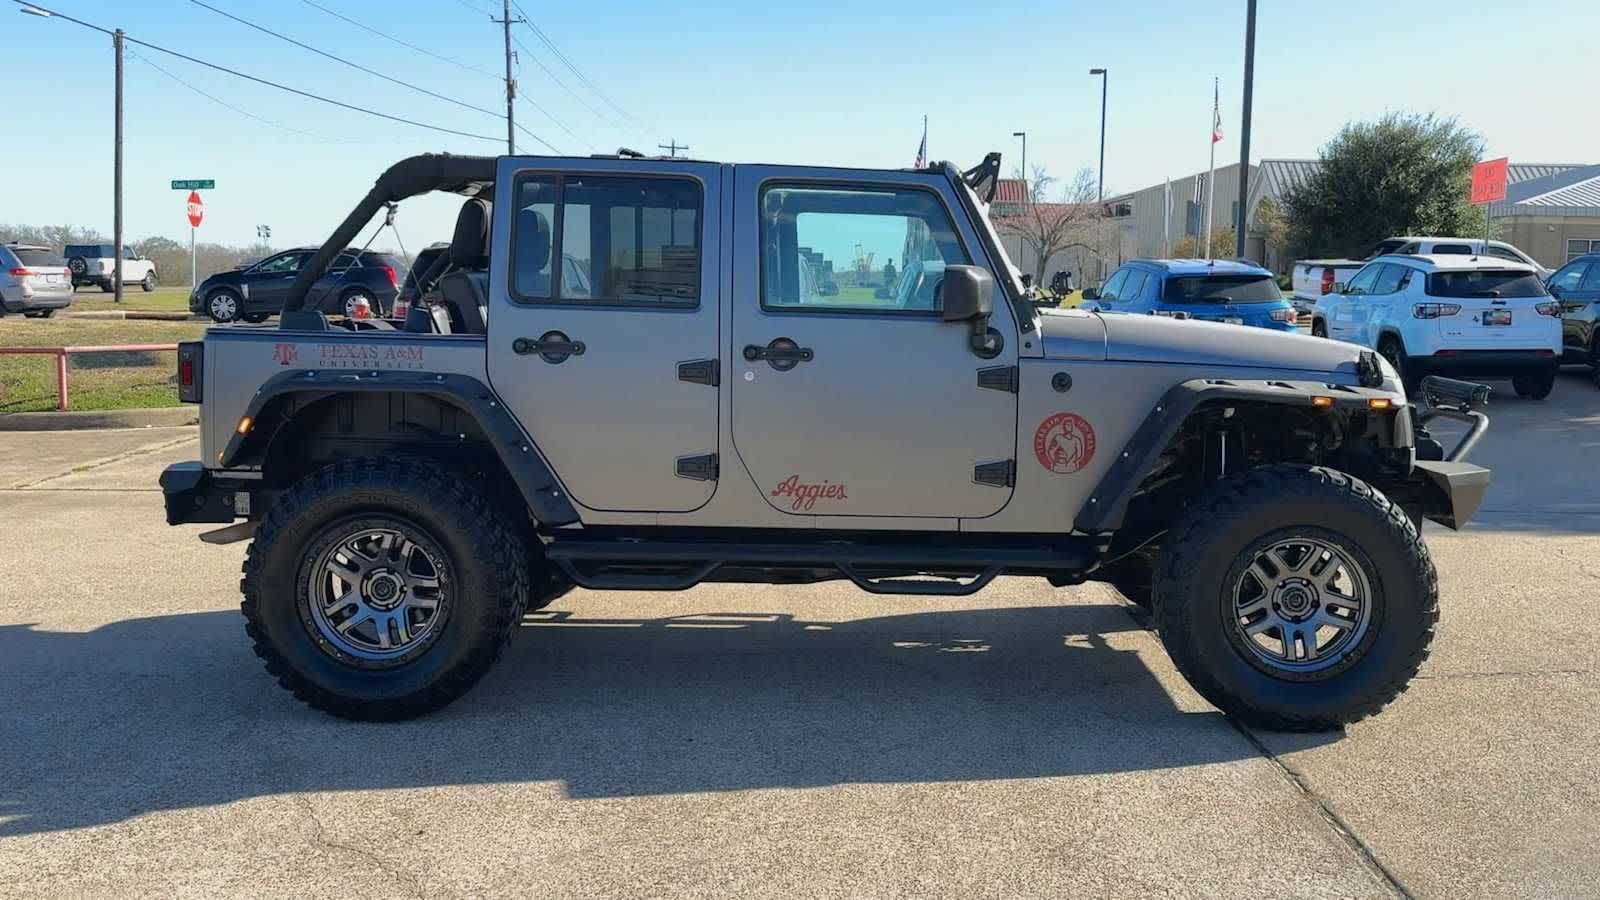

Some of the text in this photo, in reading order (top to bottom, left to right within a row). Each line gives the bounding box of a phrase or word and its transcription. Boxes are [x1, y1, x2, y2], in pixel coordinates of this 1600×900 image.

[188, 202, 204, 216] STOP
[320, 344, 424, 361] TEXAS A&M
[771, 474, 848, 511] Aggies
